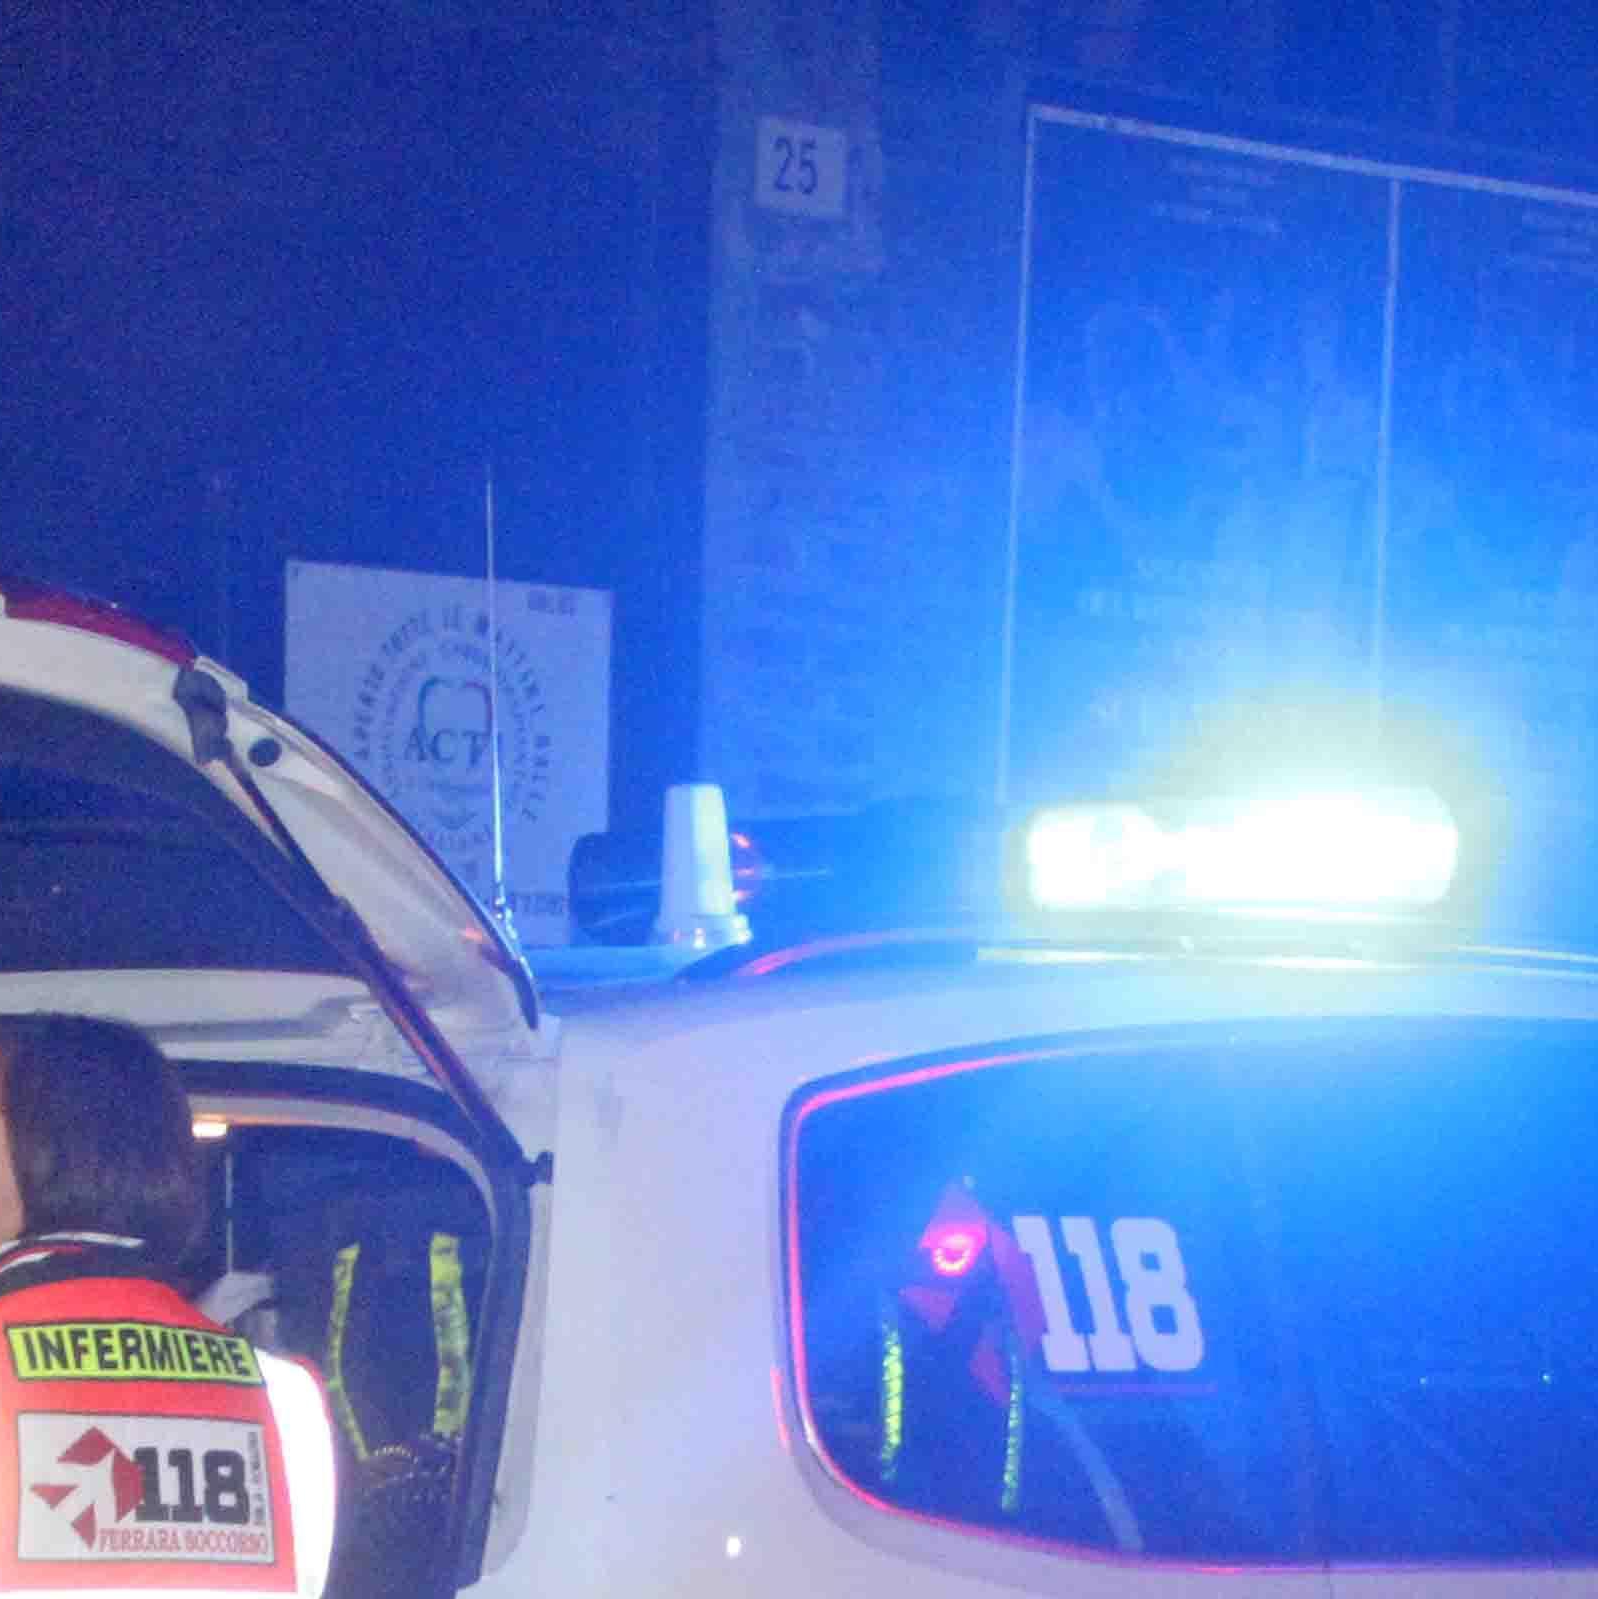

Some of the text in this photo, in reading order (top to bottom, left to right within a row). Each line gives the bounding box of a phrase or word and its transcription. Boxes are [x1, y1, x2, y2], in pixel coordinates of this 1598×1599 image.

[773, 136, 818, 194] 25
[1012, 1215, 1205, 1373] 118
[22, 1328, 252, 1377] INFERMIERE
[132, 1446, 251, 1525] 118
[99, 1528, 269, 1555] FERRARA SOCCORSO
